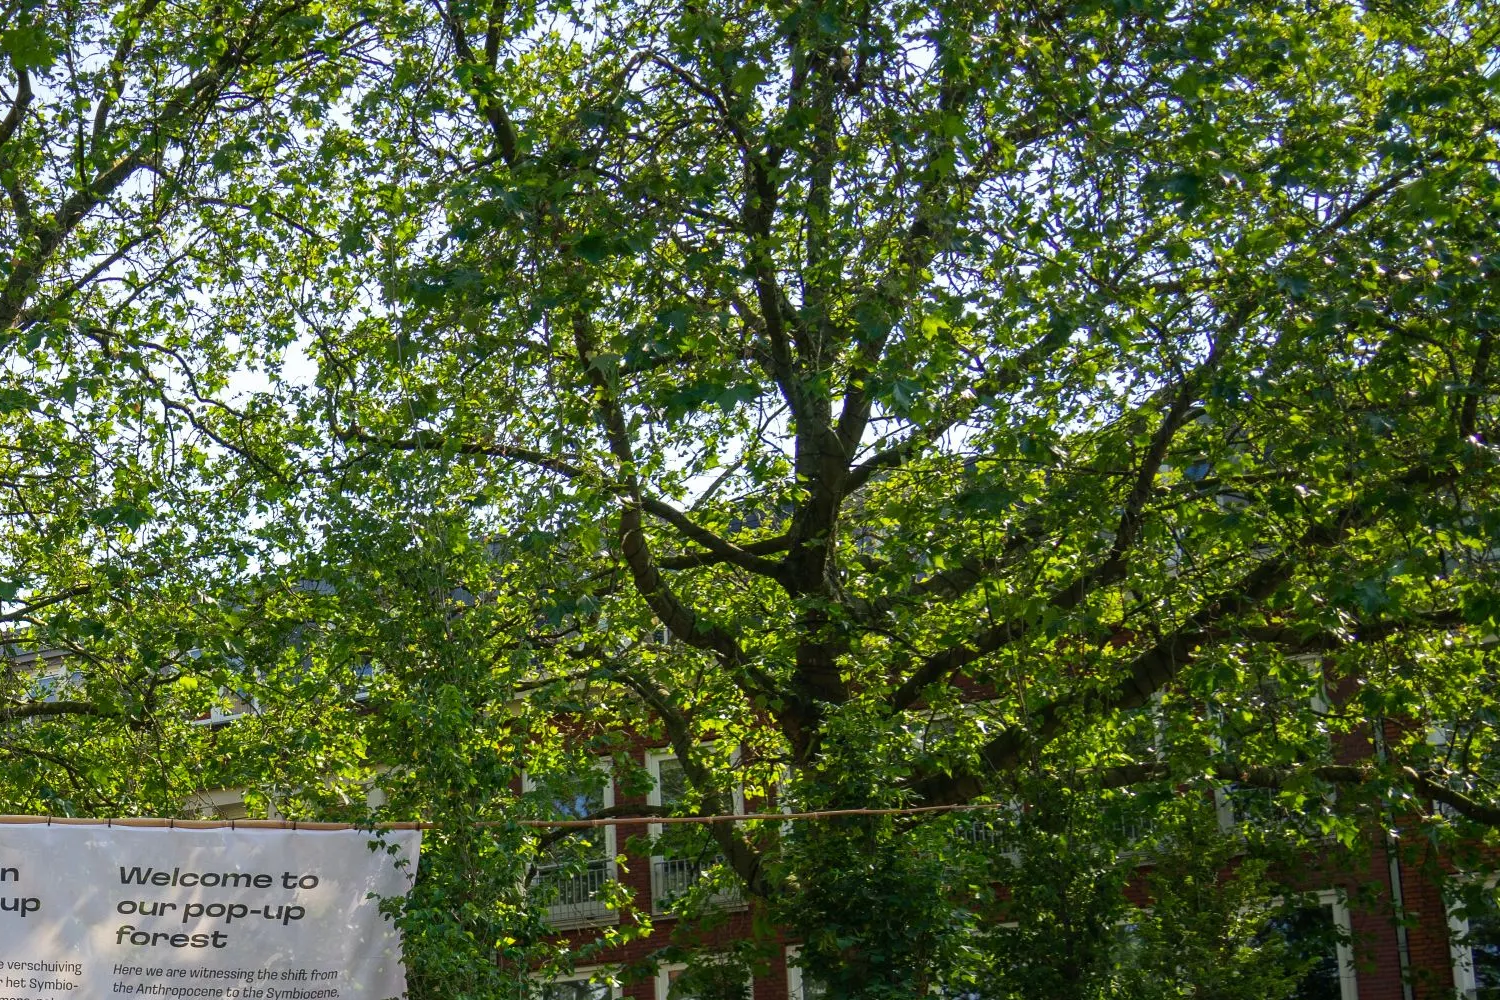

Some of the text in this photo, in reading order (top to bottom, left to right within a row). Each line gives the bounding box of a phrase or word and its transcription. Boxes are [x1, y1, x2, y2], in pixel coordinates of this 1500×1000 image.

[119, 866, 319, 890] Welcome to
[116, 900, 305, 926] our pop-up
[115, 925, 228, 949] forest
[7, 960, 82, 975] verschuiving
[113, 963, 338, 982] Here we are witnessing the shift from
[5, 976, 26, 987] het
[29, 977, 77, 993] Symbio-
[112, 981, 340, 1000] the Anthropocene to the Symbiocene,
